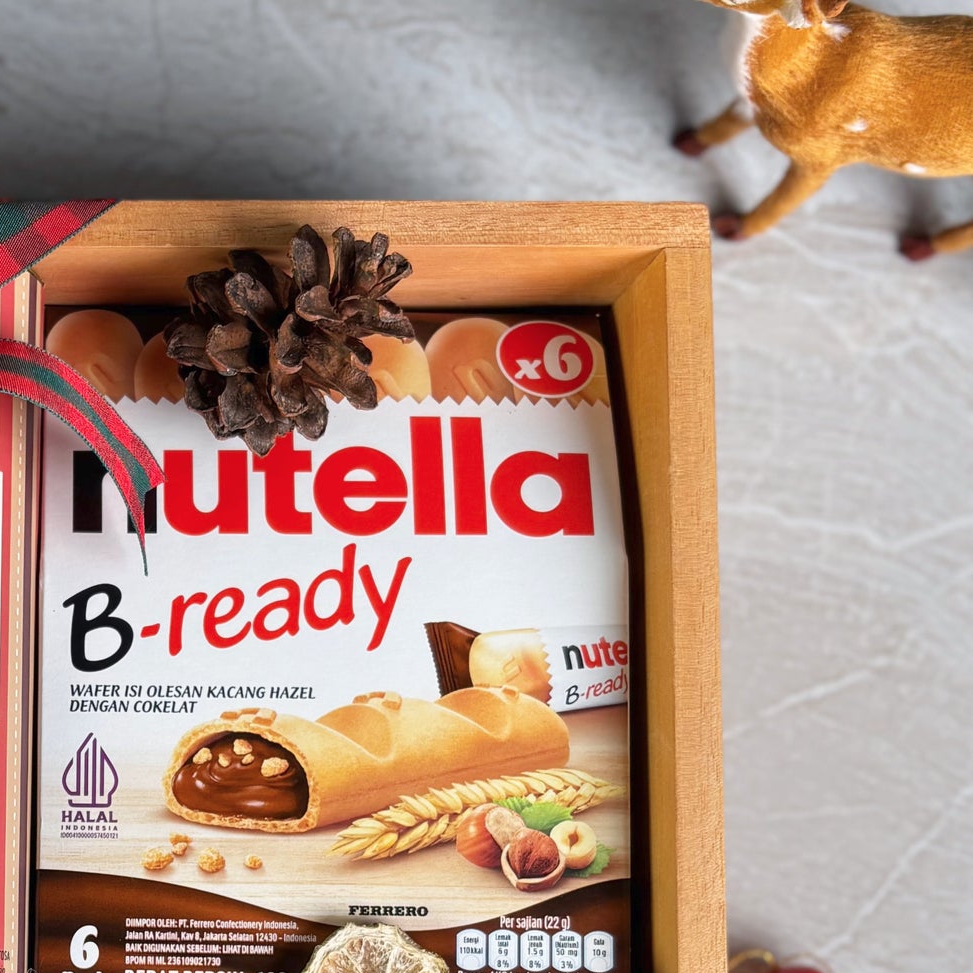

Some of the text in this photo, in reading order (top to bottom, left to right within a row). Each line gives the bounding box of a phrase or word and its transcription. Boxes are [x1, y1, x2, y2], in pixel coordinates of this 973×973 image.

[514, 335, 582, 381] x6
[62, 543, 412, 673] B-ready
[70, 684, 316, 699] WAFER ISI OLESAN KACANG HAZEL
[69, 700, 197, 714] DENGAN COKELAT
[62, 811, 118, 823] HALAL
[348, 906, 429, 917] FERRERO
[190, 919, 262, 930] Ferrero Confectionery
[500, 916, 542, 930] Per sajian
[203, 932, 227, 941] Jakarta
[229, 932, 254, 941] Selatan
[283, 934, 317, 943] Indonesia
[69, 925, 99, 969] 6
[126, 943, 185, 953] BAIK DIGUNAKAN
[125, 956, 146, 964] BPOM
